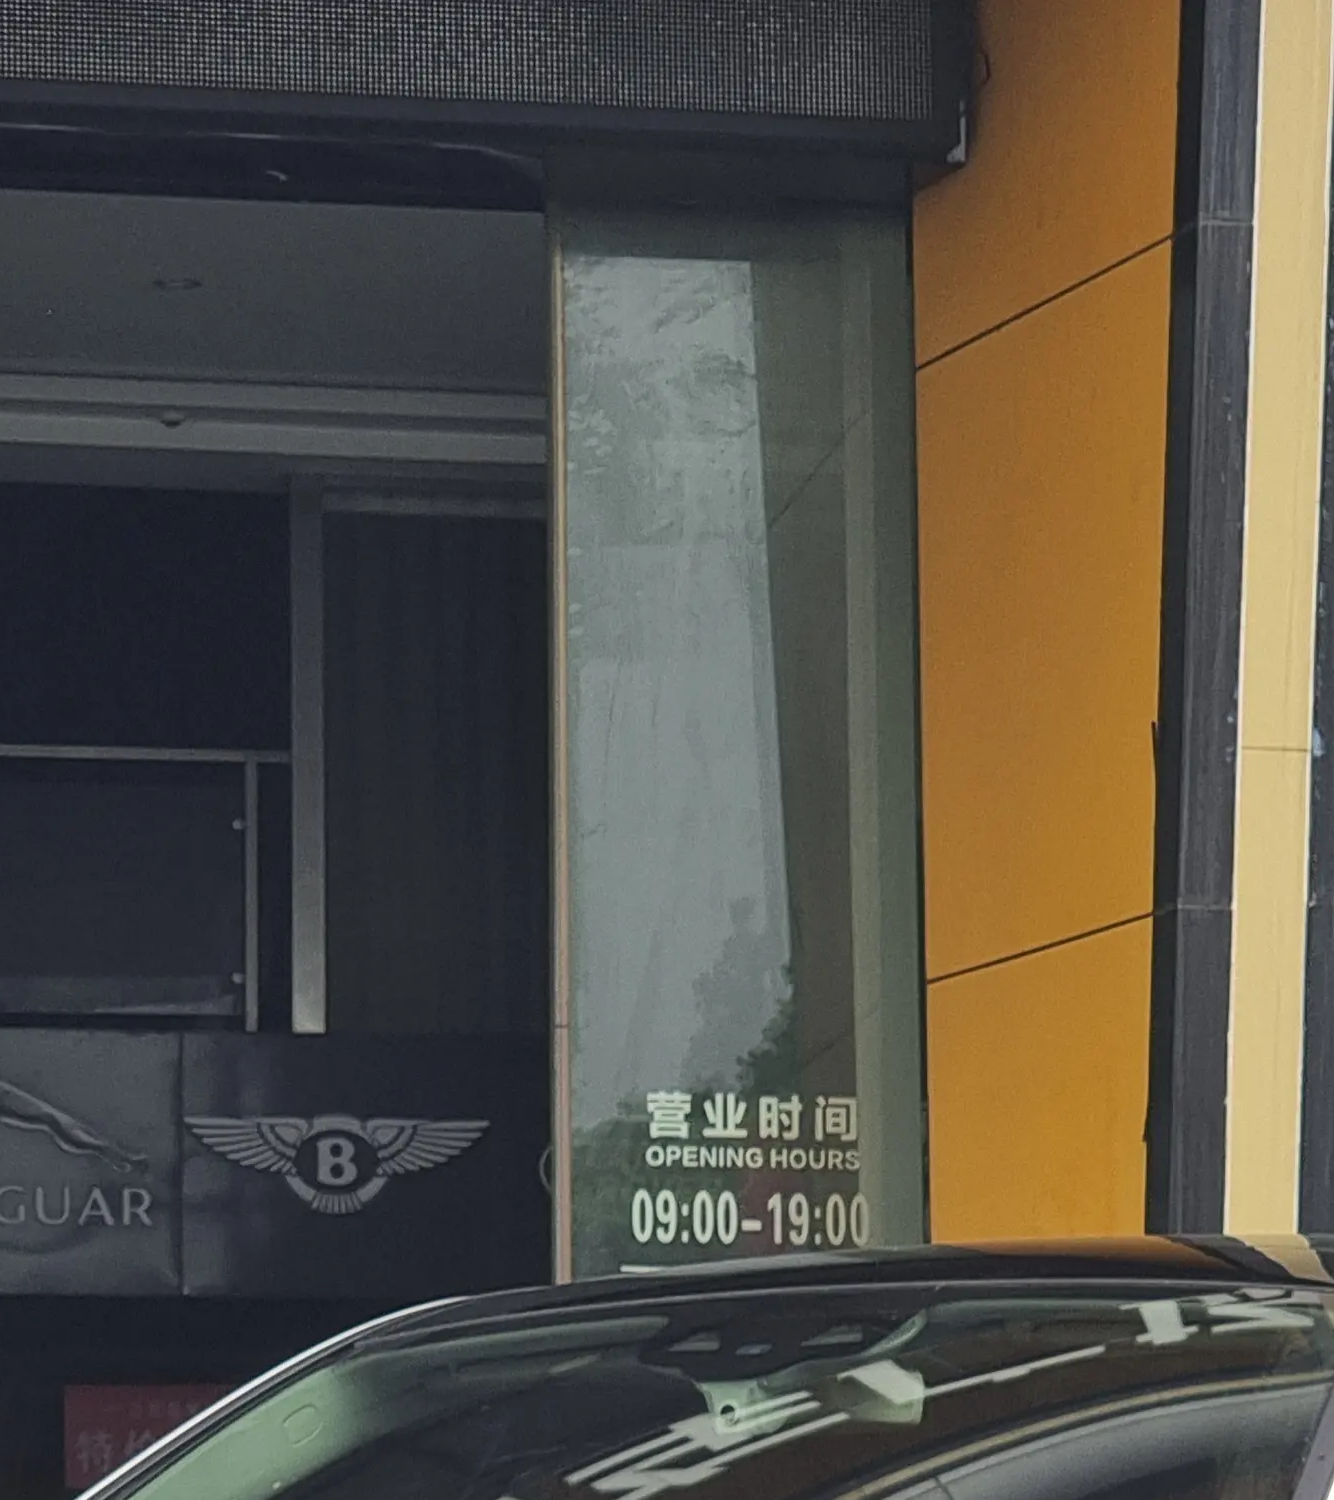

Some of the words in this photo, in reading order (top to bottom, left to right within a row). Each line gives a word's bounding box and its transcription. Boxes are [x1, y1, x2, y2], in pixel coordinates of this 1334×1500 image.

[646, 1091, 858, 1141] 营业时间
[316, 1137, 359, 1186] B
[644, 1145, 764, 1169] OPENING
[769, 1148, 862, 1171] HOURS
[630, 1188, 870, 1248] 09:00-19:00
